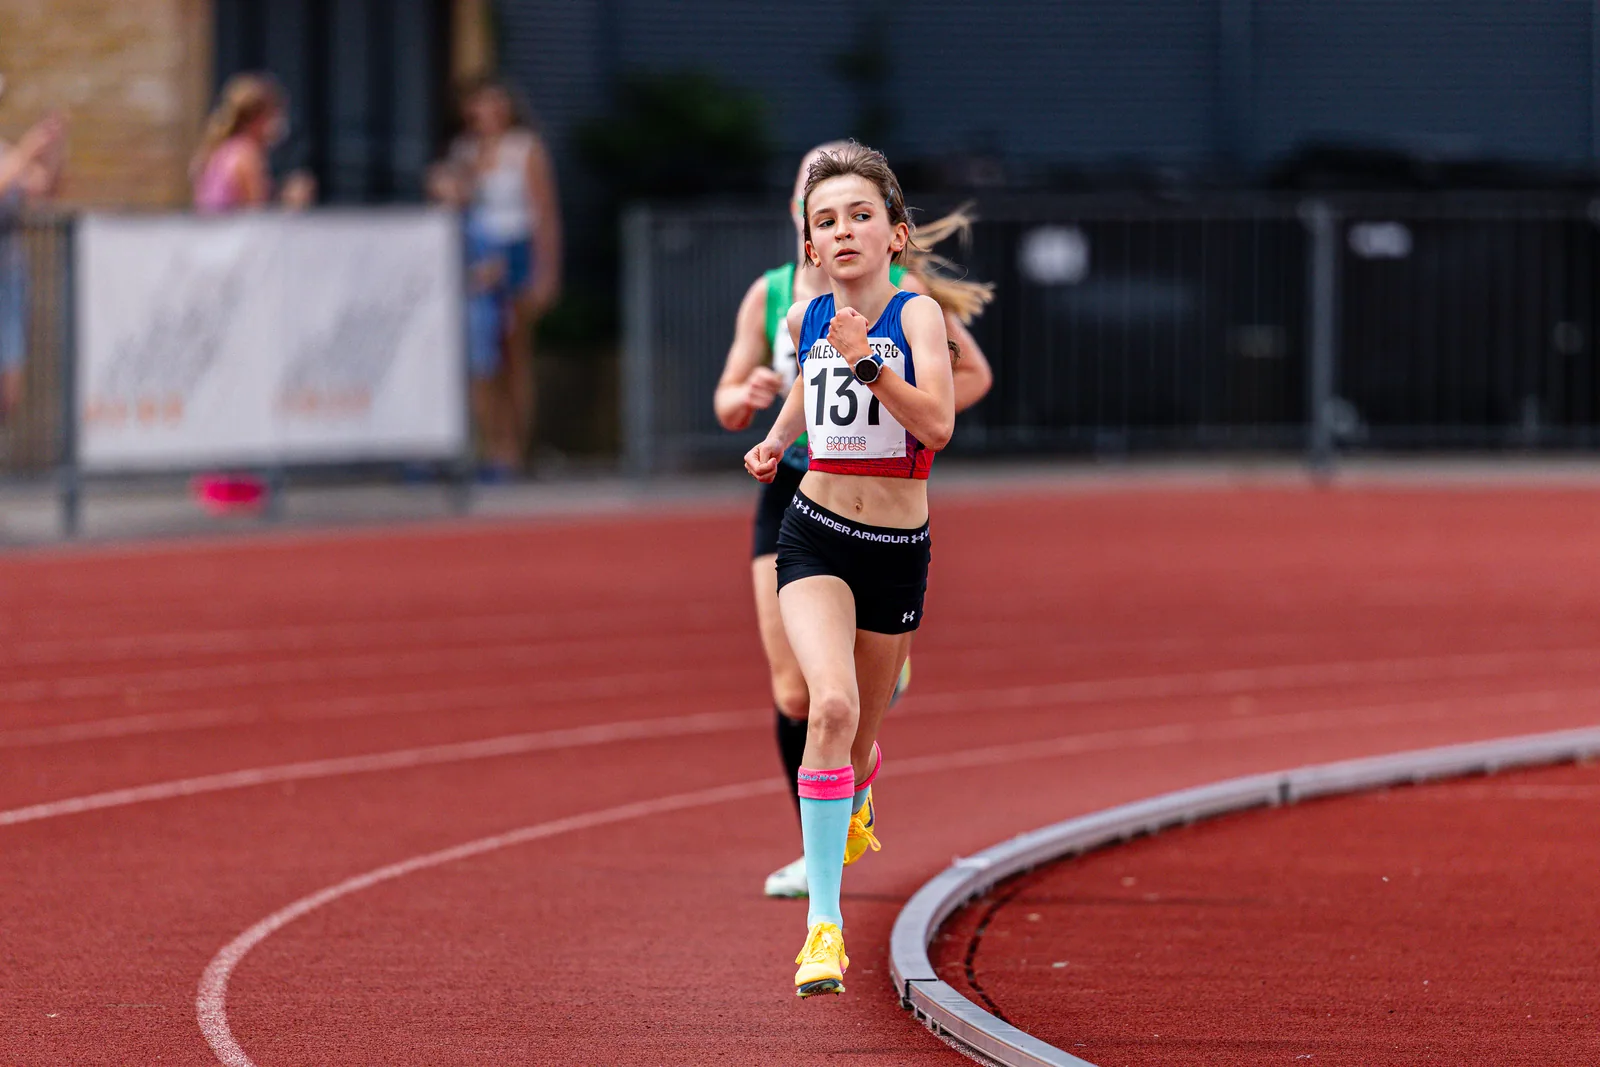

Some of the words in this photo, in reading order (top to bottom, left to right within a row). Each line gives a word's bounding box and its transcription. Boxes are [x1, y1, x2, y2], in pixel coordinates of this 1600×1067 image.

[826, 435, 867, 445] comms
[826, 443, 867, 451] express
[810, 509, 851, 536] UNDER
[851, 529, 909, 544] ARMOUR
